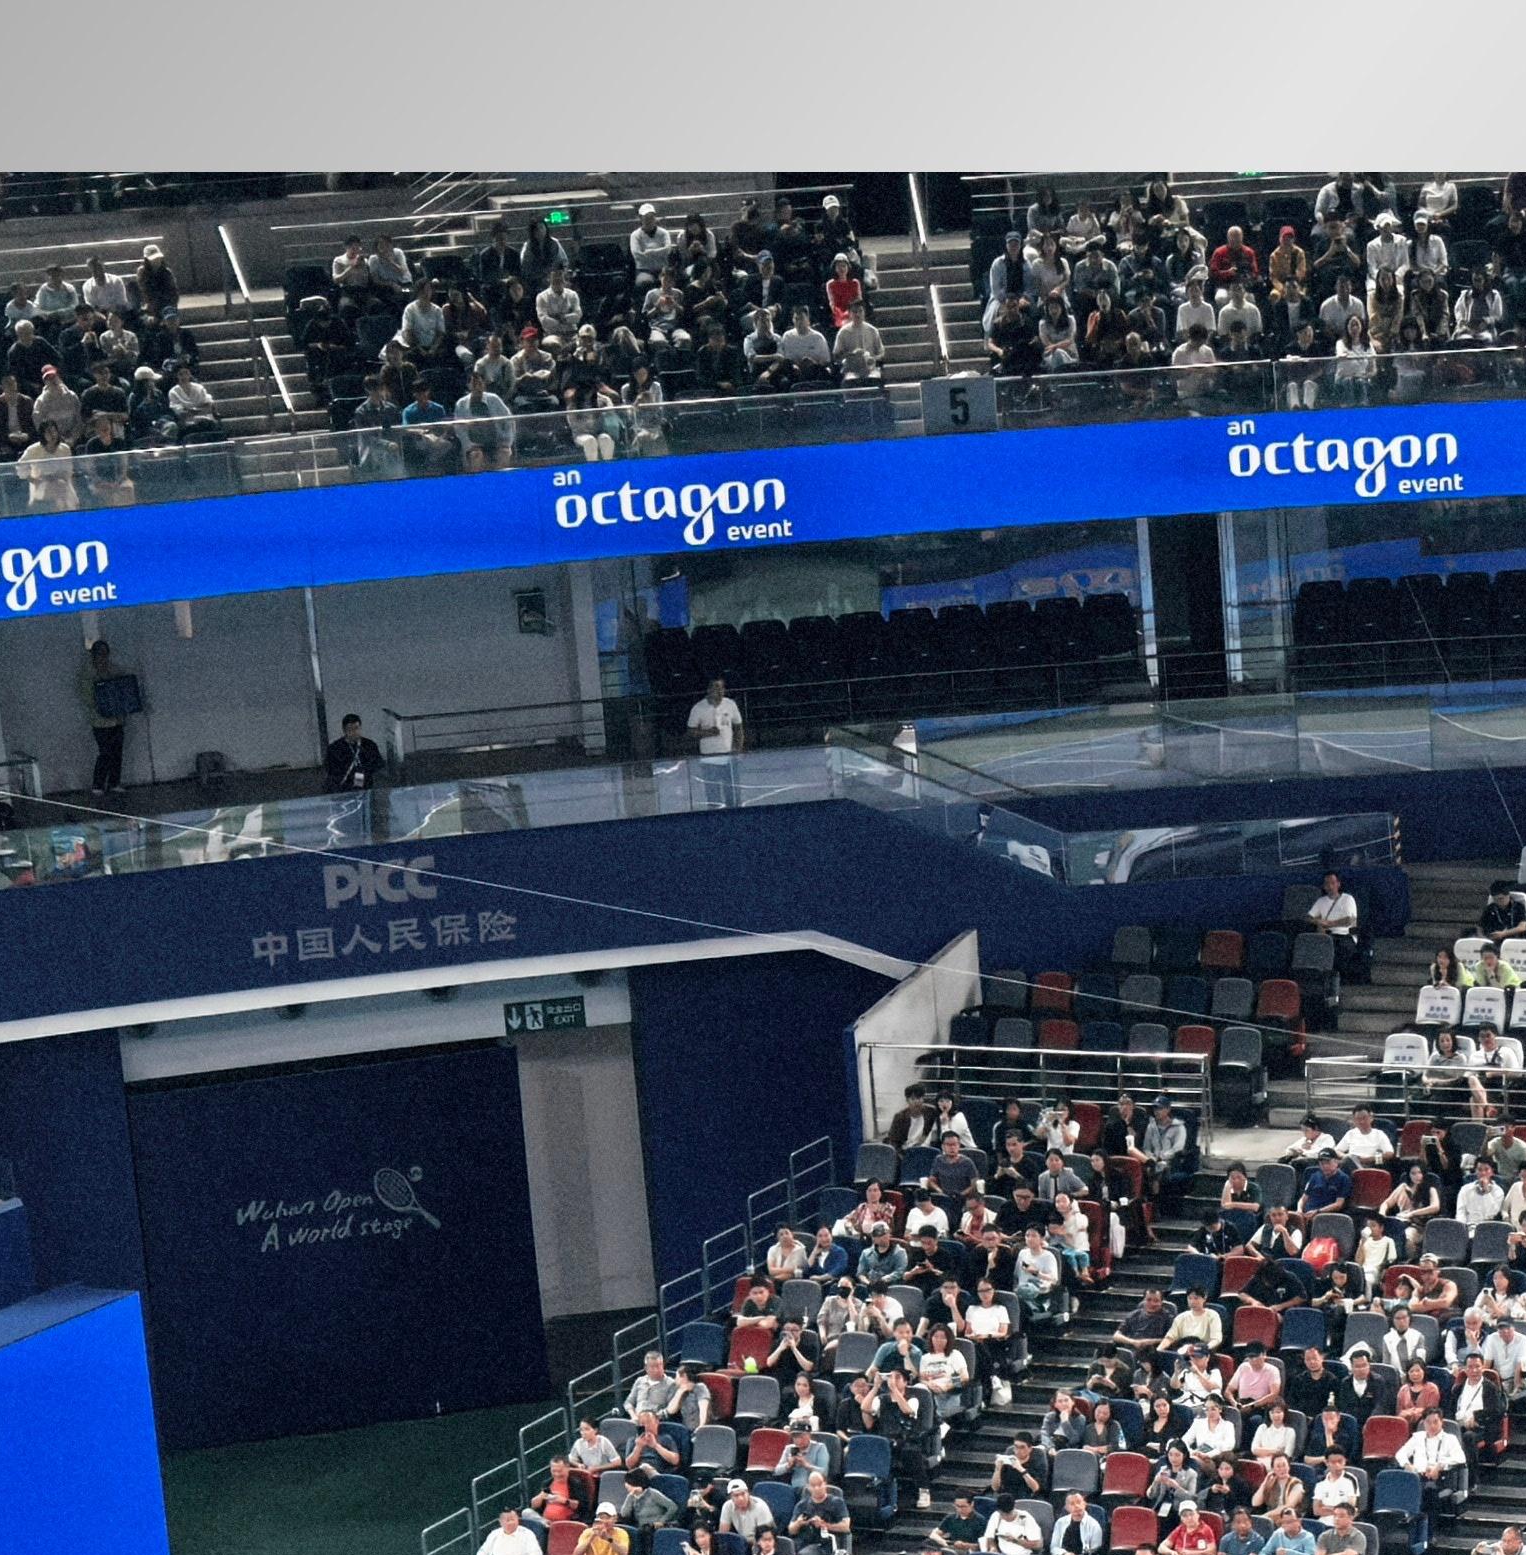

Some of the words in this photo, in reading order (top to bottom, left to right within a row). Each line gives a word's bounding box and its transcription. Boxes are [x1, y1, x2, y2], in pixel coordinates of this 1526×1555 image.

[949, 388, 970, 426] 5
[1227, 419, 1255, 436] an
[553, 470, 582, 487] an
[1228, 433, 1458, 497] octagon
[1397, 473, 1464, 494] event
[555, 478, 786, 545] octagon
[726, 519, 793, 541] event
[50, 583, 117, 605] event
[325, 855, 438, 909] PICC
[252, 909, 517, 966] 中国人民保险
[323, 1190, 373, 1216] Open
[261, 1222, 280, 1252] A
